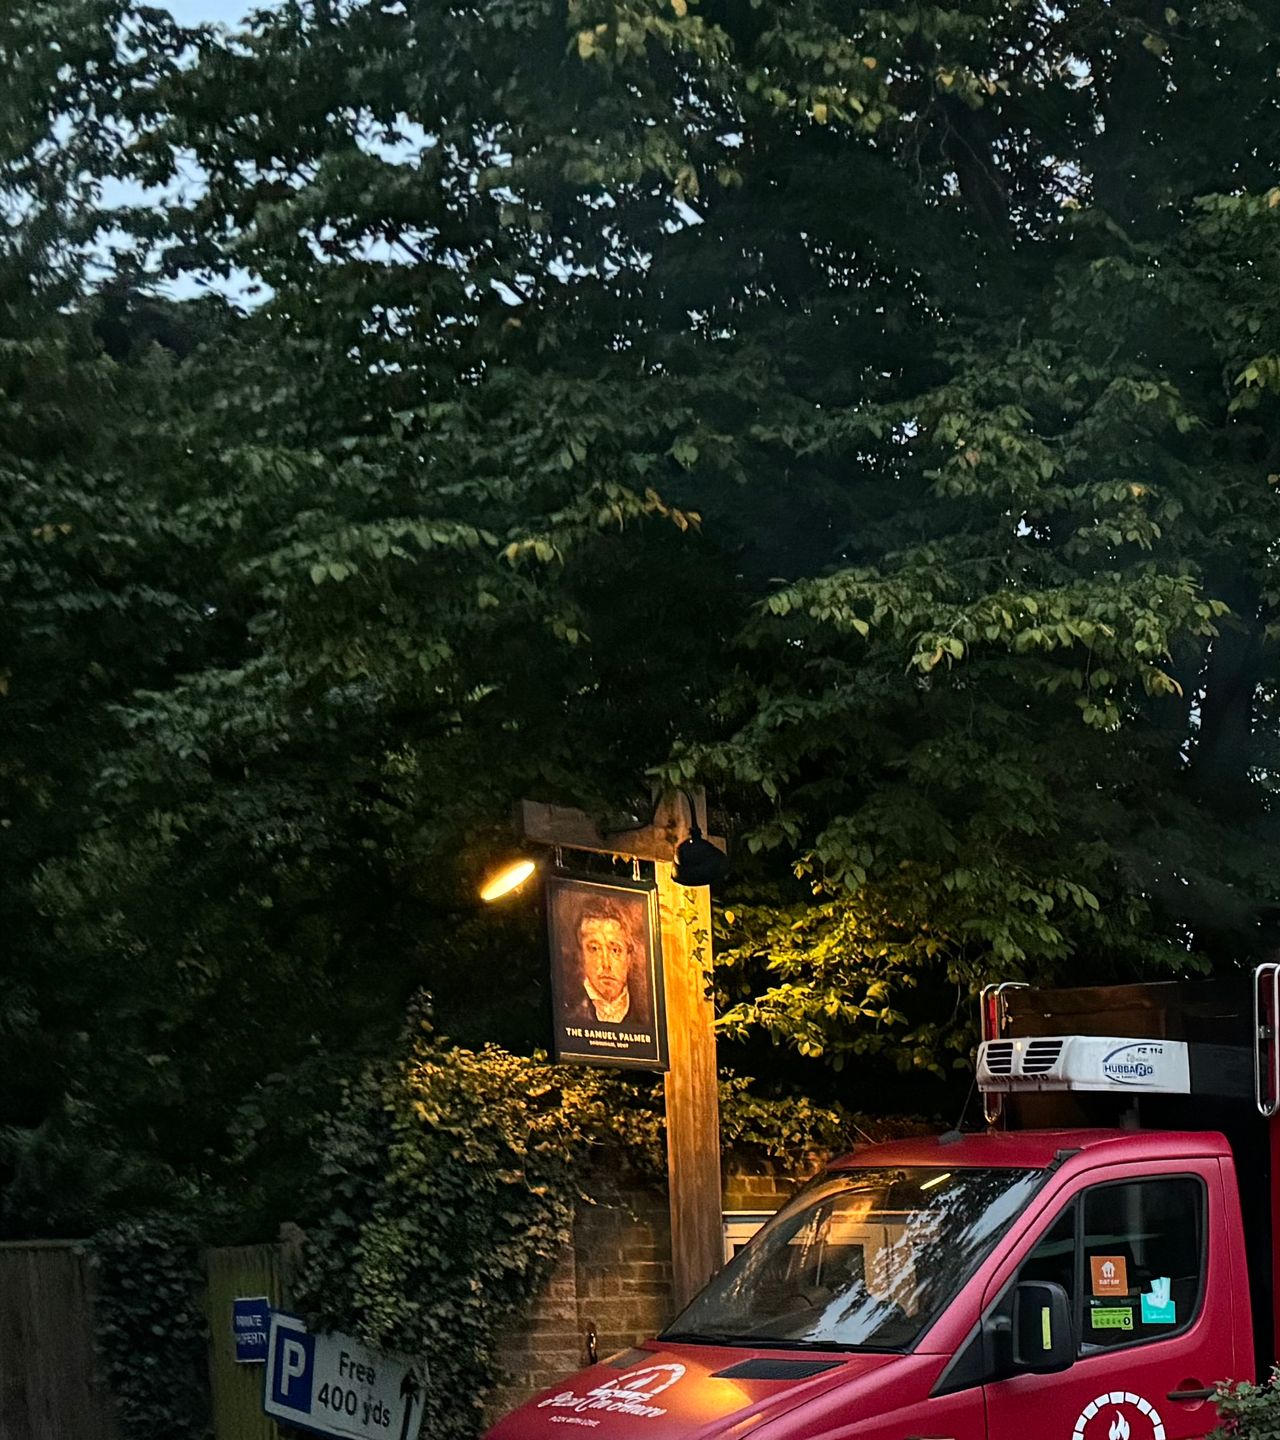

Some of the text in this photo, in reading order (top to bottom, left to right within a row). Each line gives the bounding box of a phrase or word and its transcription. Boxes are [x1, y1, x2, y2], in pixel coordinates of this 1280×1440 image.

[565, 1027, 651, 1043] THE SAMUEL PALMER
[1150, 1047, 1163, 1055] 114
[1104, 1063, 1153, 1077] HUBBARD
[281, 1338, 306, 1396] P
[339, 1351, 376, 1386] Free
[318, 1383, 390, 1428] 400 yds
